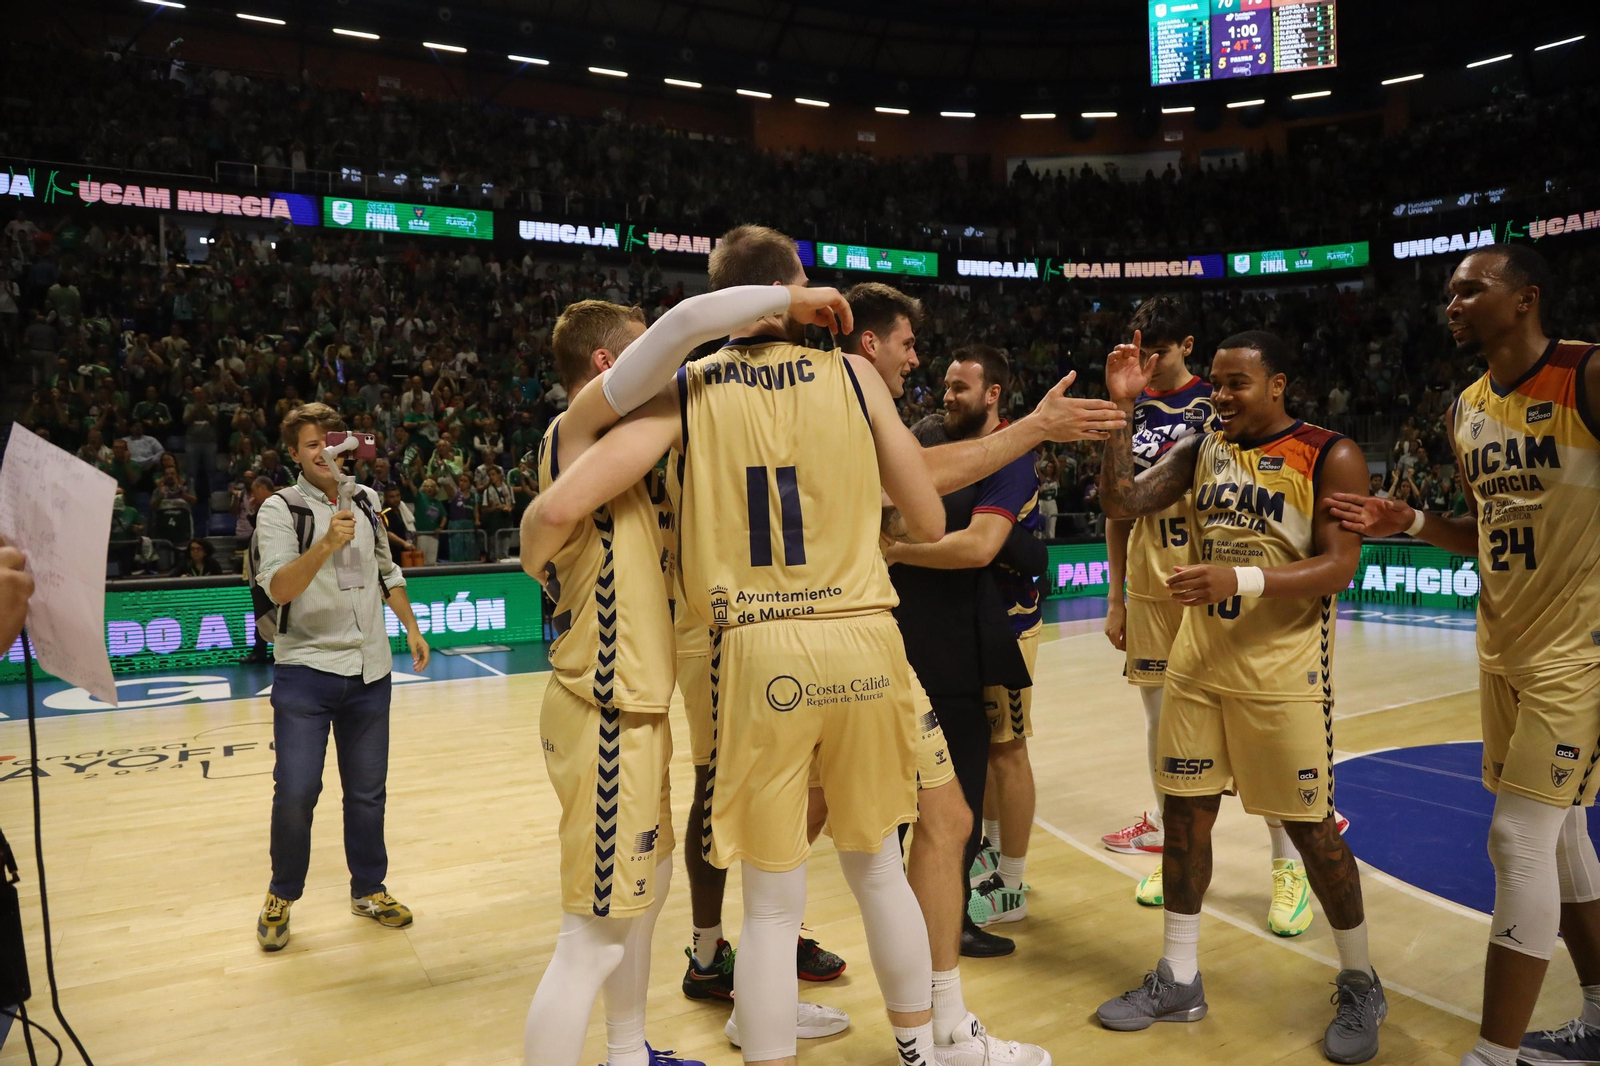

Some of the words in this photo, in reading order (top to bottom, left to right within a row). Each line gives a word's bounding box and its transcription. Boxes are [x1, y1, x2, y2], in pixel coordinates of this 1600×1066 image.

[1228, 24, 1258, 39] 1:00
[1233, 39, 1250, 51] 4T
[1218, 57, 1227, 69] 5
[1257, 52, 1267, 65] 3
[78, 180, 172, 210] UCAM
[177, 189, 293, 220] MURCIA
[365, 212, 401, 232] FINAL
[518, 220, 620, 248] UNICAJA
[648, 232, 711, 254] UCAM
[1393, 229, 1496, 260] UNICAJA
[845, 255, 872, 270] FINAL
[956, 259, 1039, 279] UNICAJA
[1063, 262, 1121, 279] UCAM
[1125, 260, 1204, 277] MURCIA
[1260, 259, 1289, 274] FINAL
[704, 354, 816, 391] RADOVIĆ
[1464, 435, 1562, 484] UCAM
[1477, 474, 1546, 499] MURCIA
[1196, 482, 1286, 524] UCAM
[1526, 503, 1543, 511] 2024
[745, 466, 807, 567] 11
[1203, 510, 1267, 535] MURCIA
[1159, 517, 1189, 549] 15
[1231, 549, 1247, 557] CRUZ
[1248, 549, 1264, 557] 2024
[1489, 526, 1537, 571] 24
[1361, 561, 1480, 597] AFICIÓ
[735, 586, 843, 605] Ayuntamiento
[737, 610, 755, 625] de
[759, 604, 816, 622] Murcia
[805, 682, 847, 697] Costa
[850, 674, 891, 693] Cálida
[806, 696, 838, 708] Región
[840, 694, 853, 703] de
[854, 690, 884, 702] Murcia
[1557, 749, 1575, 759] acb
[83, 763, 184, 780] 2024
[1161, 756, 1215, 775] ESP
[1299, 772, 1315, 780] acb
